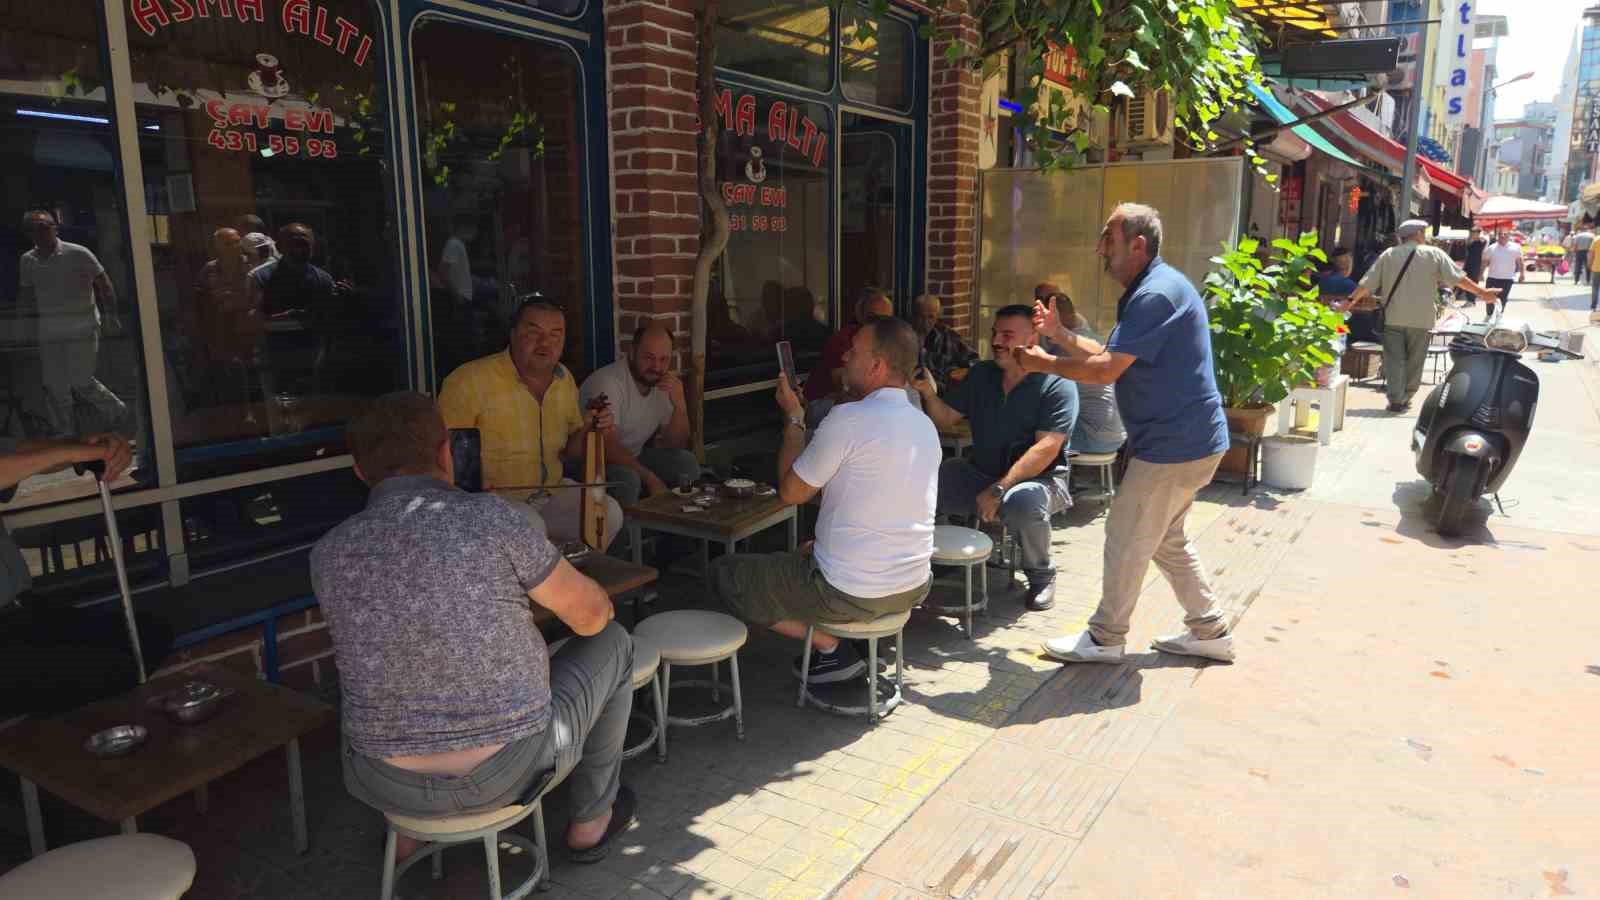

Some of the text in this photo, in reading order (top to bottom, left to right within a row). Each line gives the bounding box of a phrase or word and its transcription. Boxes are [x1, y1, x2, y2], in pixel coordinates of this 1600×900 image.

[282, 0, 373, 66] ALTI
[206, 99, 272, 129] ÇAY
[208, 129, 337, 158] 431 55 93
[768, 101, 828, 168] ALTI
[727, 214, 746, 232] 31
[752, 215, 769, 231] 55
